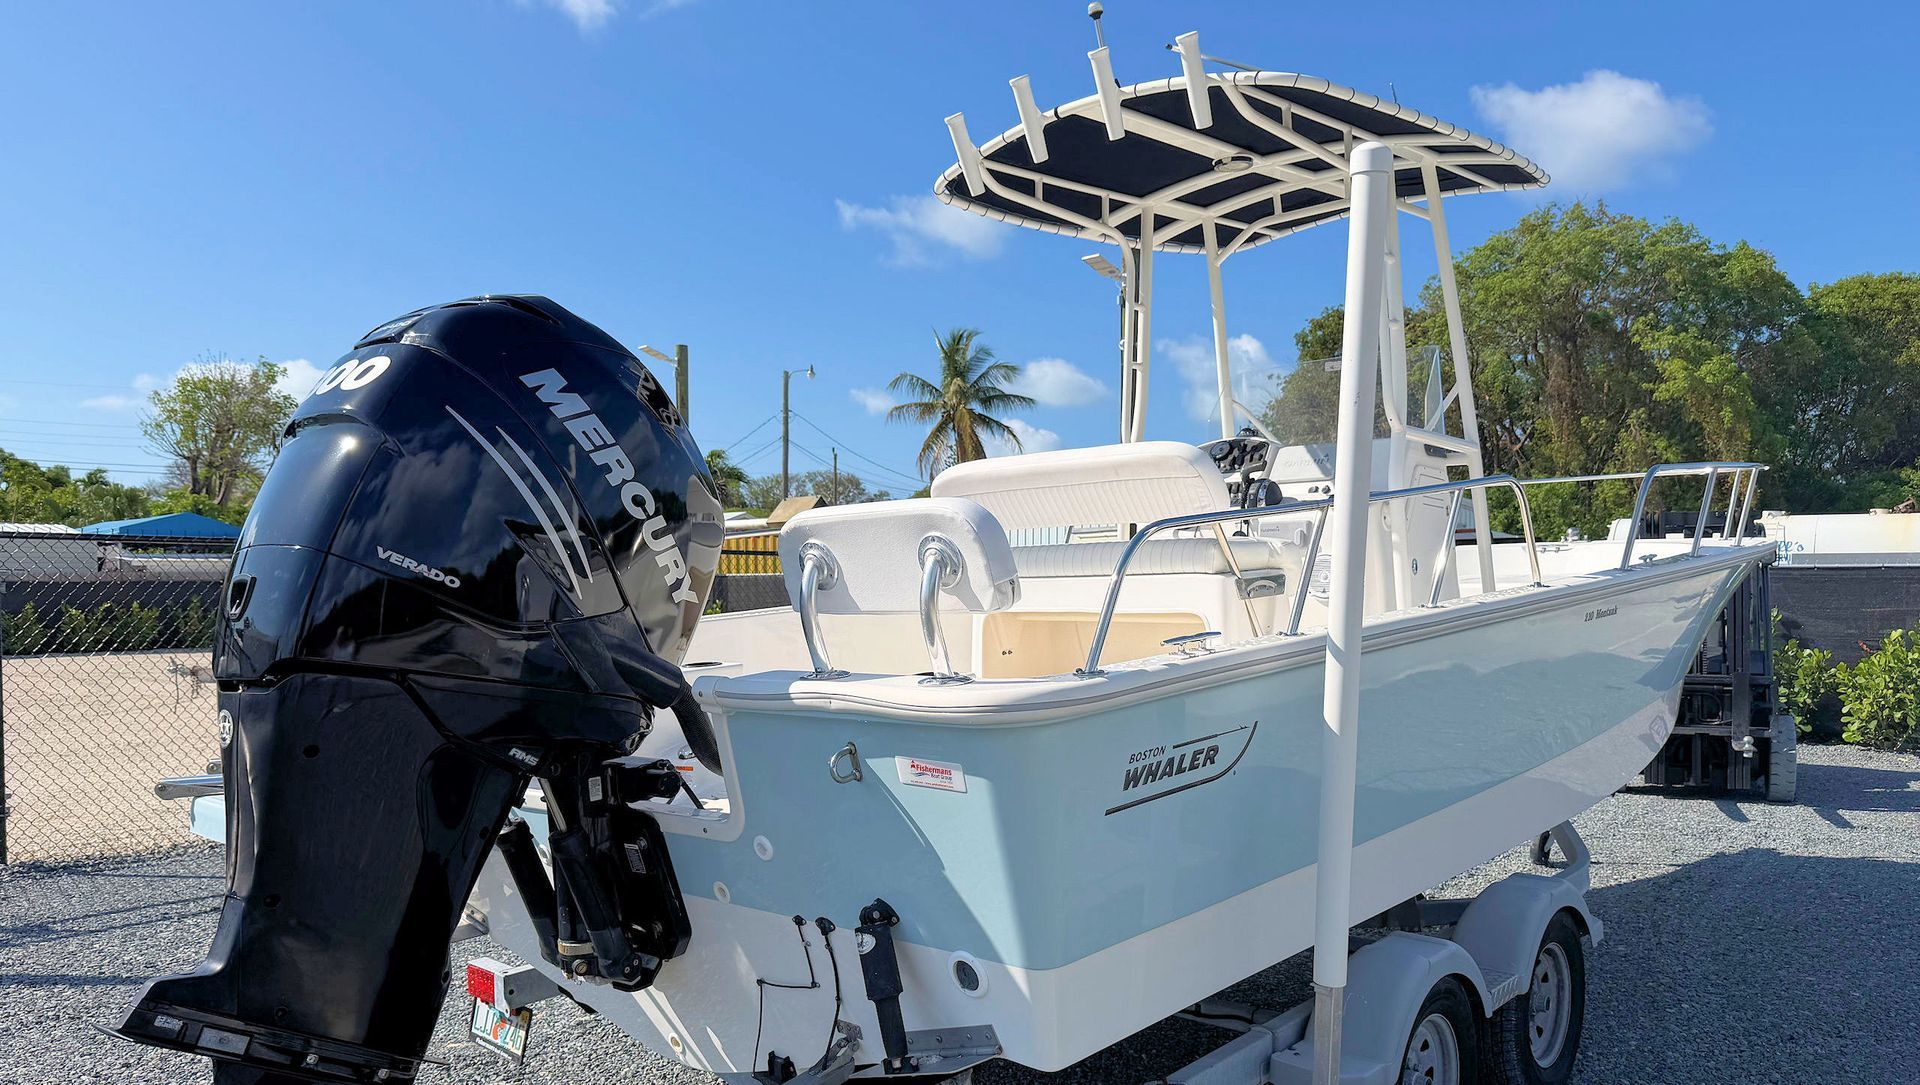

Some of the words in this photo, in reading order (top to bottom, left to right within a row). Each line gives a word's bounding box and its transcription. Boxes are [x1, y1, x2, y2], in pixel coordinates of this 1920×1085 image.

[303, 356, 392, 397] 00
[519, 367, 699, 604] MERCURY
[376, 545, 461, 588] VERADO
[916, 763, 952, 776] Fishermans
[1122, 744, 1220, 791] WHALER
[1128, 745, 1167, 764] BOSTON
